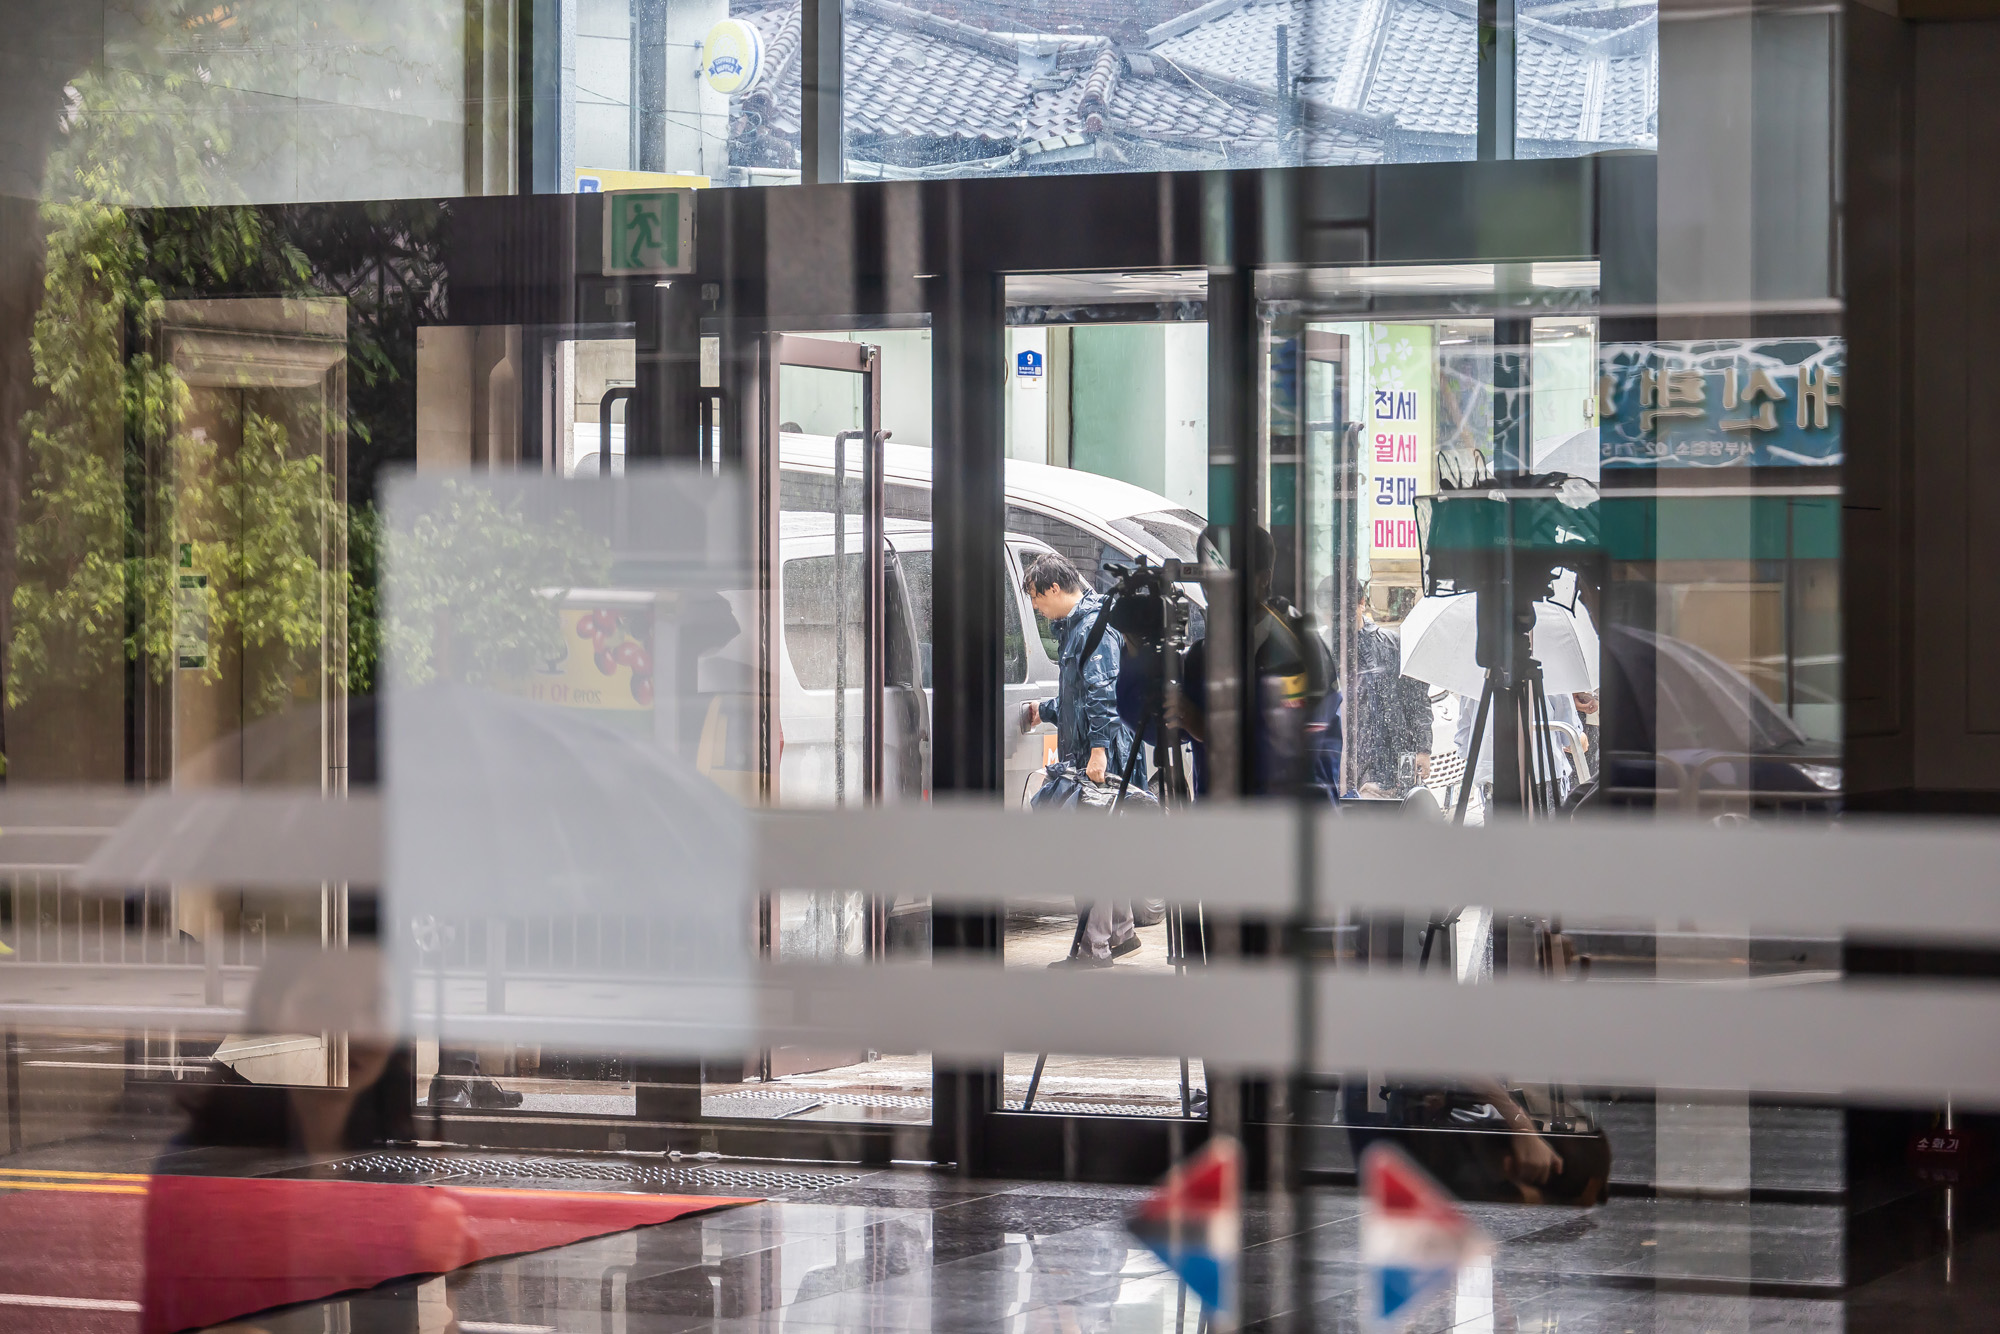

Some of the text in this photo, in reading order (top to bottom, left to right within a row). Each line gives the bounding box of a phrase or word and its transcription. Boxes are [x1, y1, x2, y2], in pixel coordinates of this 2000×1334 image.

[1026, 353, 1034, 365] 9
[1374, 390, 1417, 420] 전세
[1374, 433, 1417, 463] 월세
[1374, 476, 1417, 506] 경매
[1374, 519, 1417, 548] 매매
[1917, 1137, 1959, 1149] 소화기
